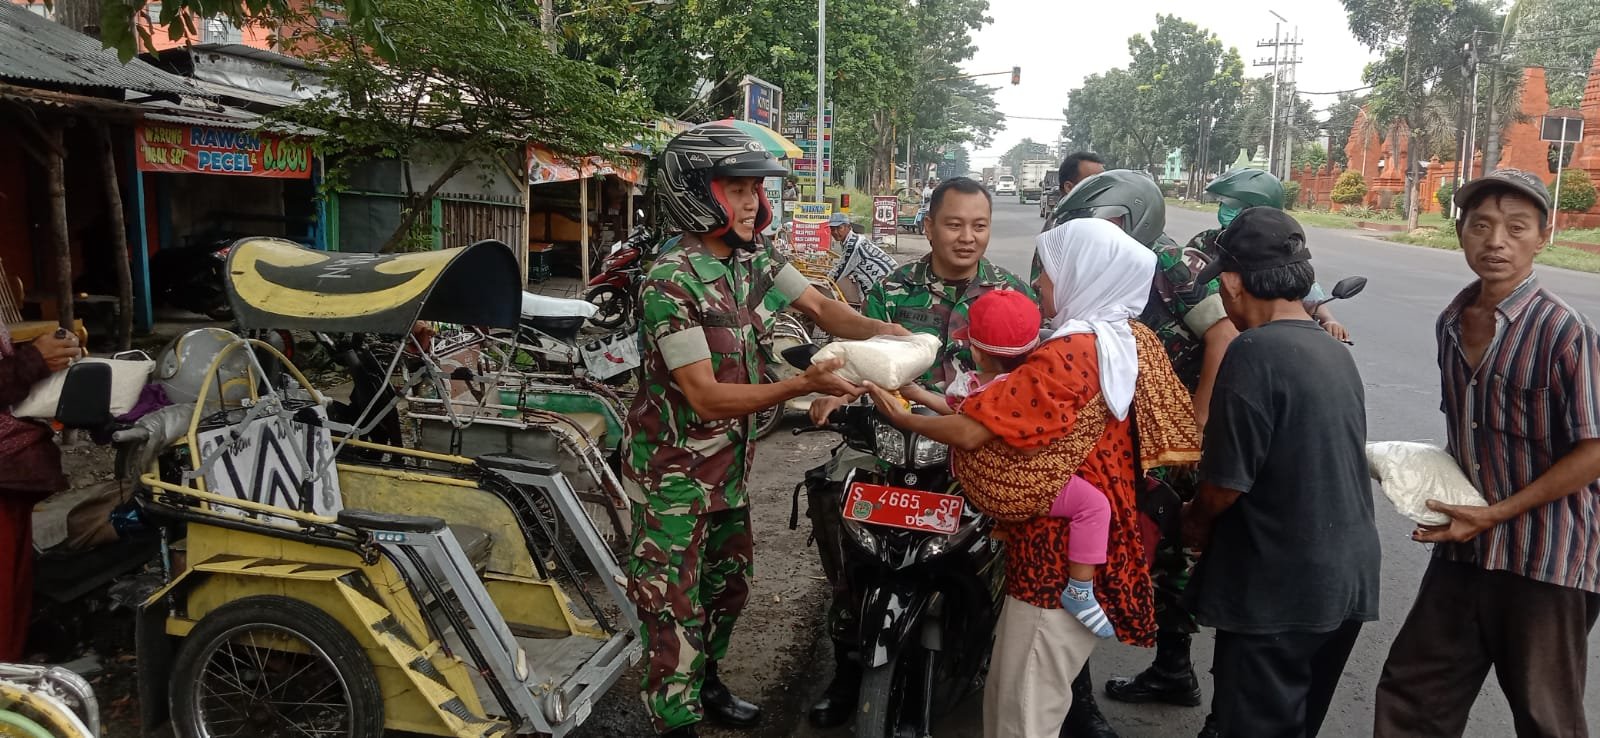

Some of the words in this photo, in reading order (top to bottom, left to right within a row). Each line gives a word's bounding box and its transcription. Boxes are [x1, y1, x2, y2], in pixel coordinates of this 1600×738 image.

[145, 127, 181, 145] WARUNG
[198, 151, 252, 172] PECEL
[852, 486, 864, 501] S
[878, 490, 921, 509] 4665
[939, 498, 960, 515] SP
